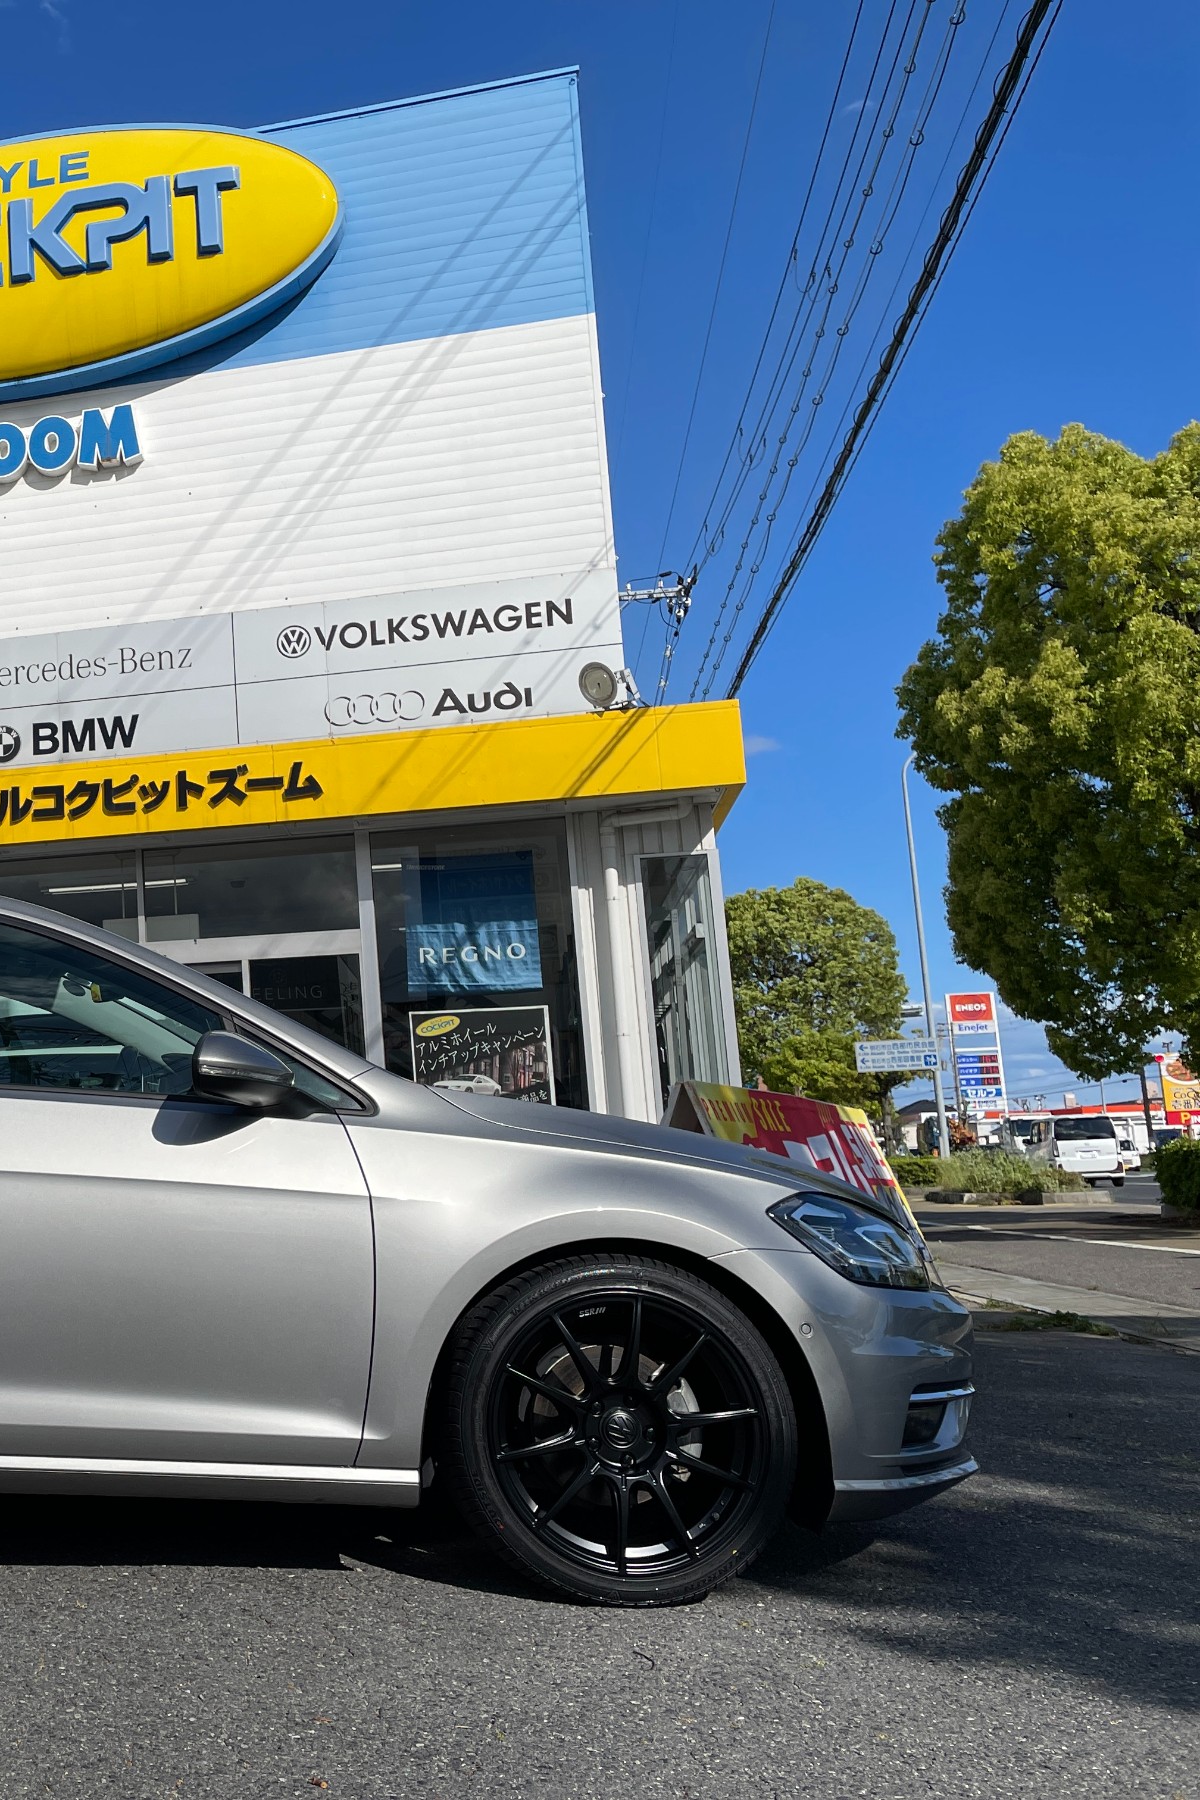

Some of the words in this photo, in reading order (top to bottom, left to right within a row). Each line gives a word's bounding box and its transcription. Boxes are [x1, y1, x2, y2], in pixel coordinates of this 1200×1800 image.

[314, 598, 573, 651] VOLKSWAGEN
[432, 681, 533, 717] Audi
[32, 714, 139, 756] BMW
[419, 943, 526, 965] REGNO
[955, 1003, 987, 1011] ENEOS
[415, 1022, 497, 1057] アルミホイール
[420, 1019, 455, 1034] COCKPIT
[418, 1025, 544, 1074] インチアップキャンペーン
[966, 1088, 997, 1098] セルフ
[751, 1097, 792, 1133] SALE
